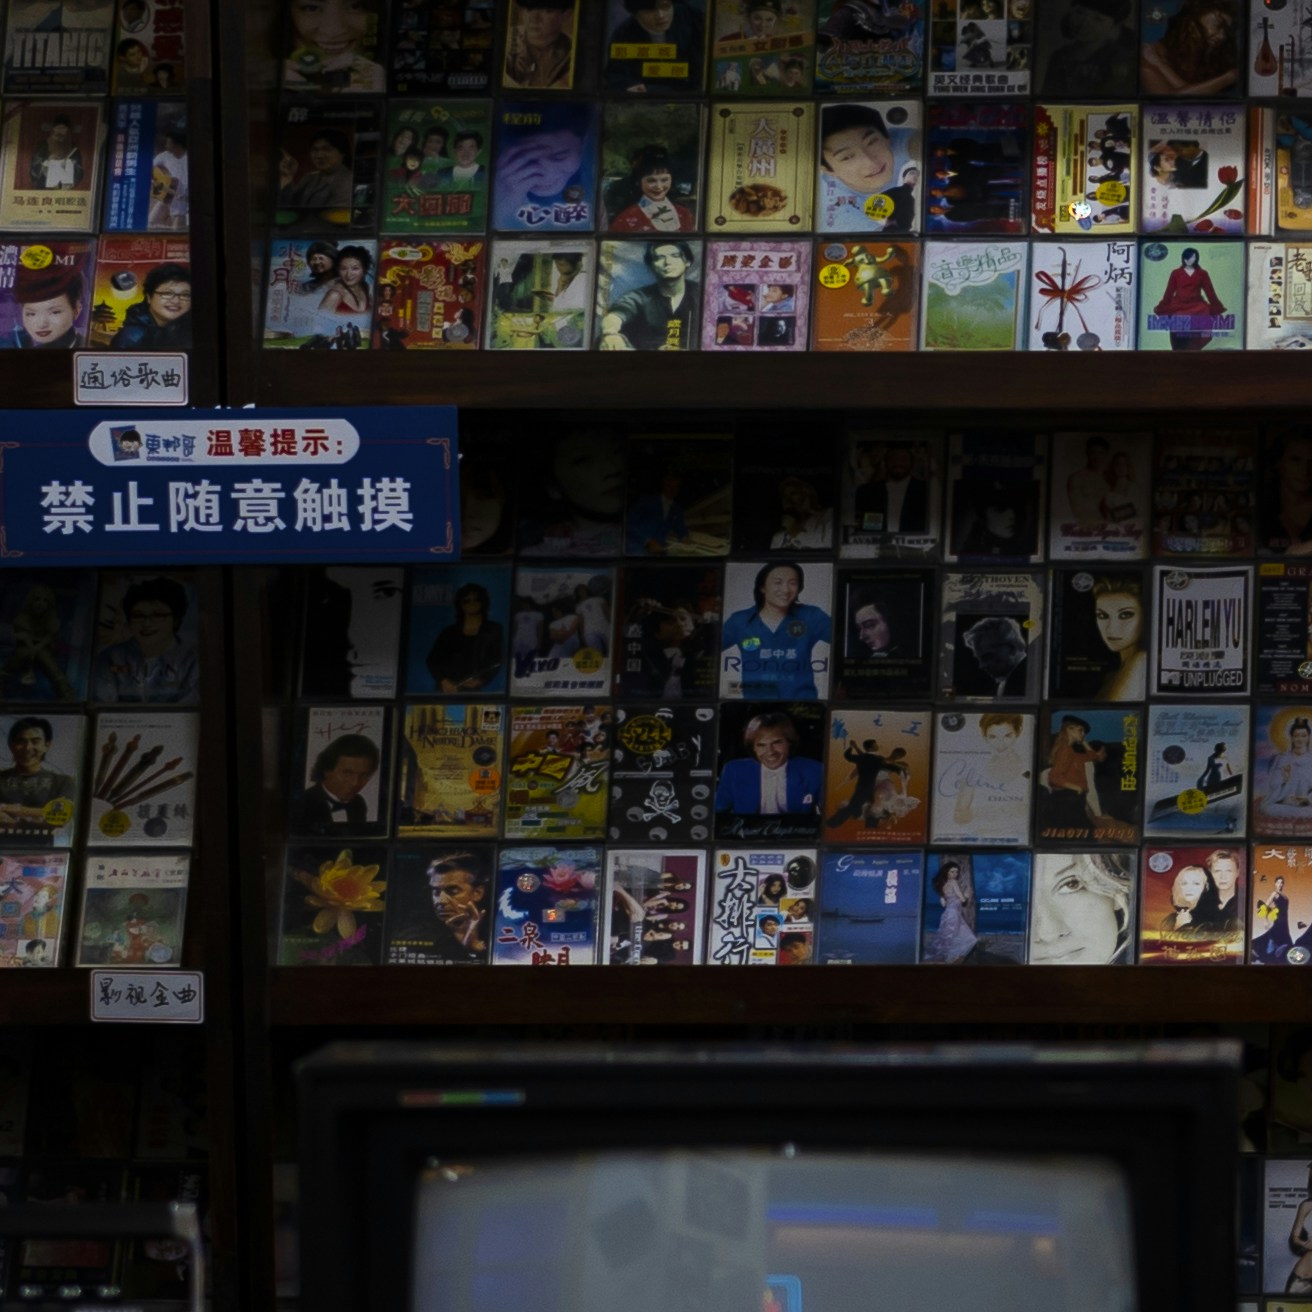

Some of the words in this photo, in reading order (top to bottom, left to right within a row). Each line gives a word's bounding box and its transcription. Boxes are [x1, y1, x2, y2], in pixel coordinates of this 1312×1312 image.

[12, 31, 105, 67] TITANIC
[80, 362, 182, 390] 通俗歌曲
[39, 476, 415, 536] 禁止随意触摸
[1166, 598, 1221, 649] HARLEM
[1224, 598, 1242, 649] YU
[723, 655, 829, 675] Ronald
[1184, 671, 1244, 688] UNPLUGGED
